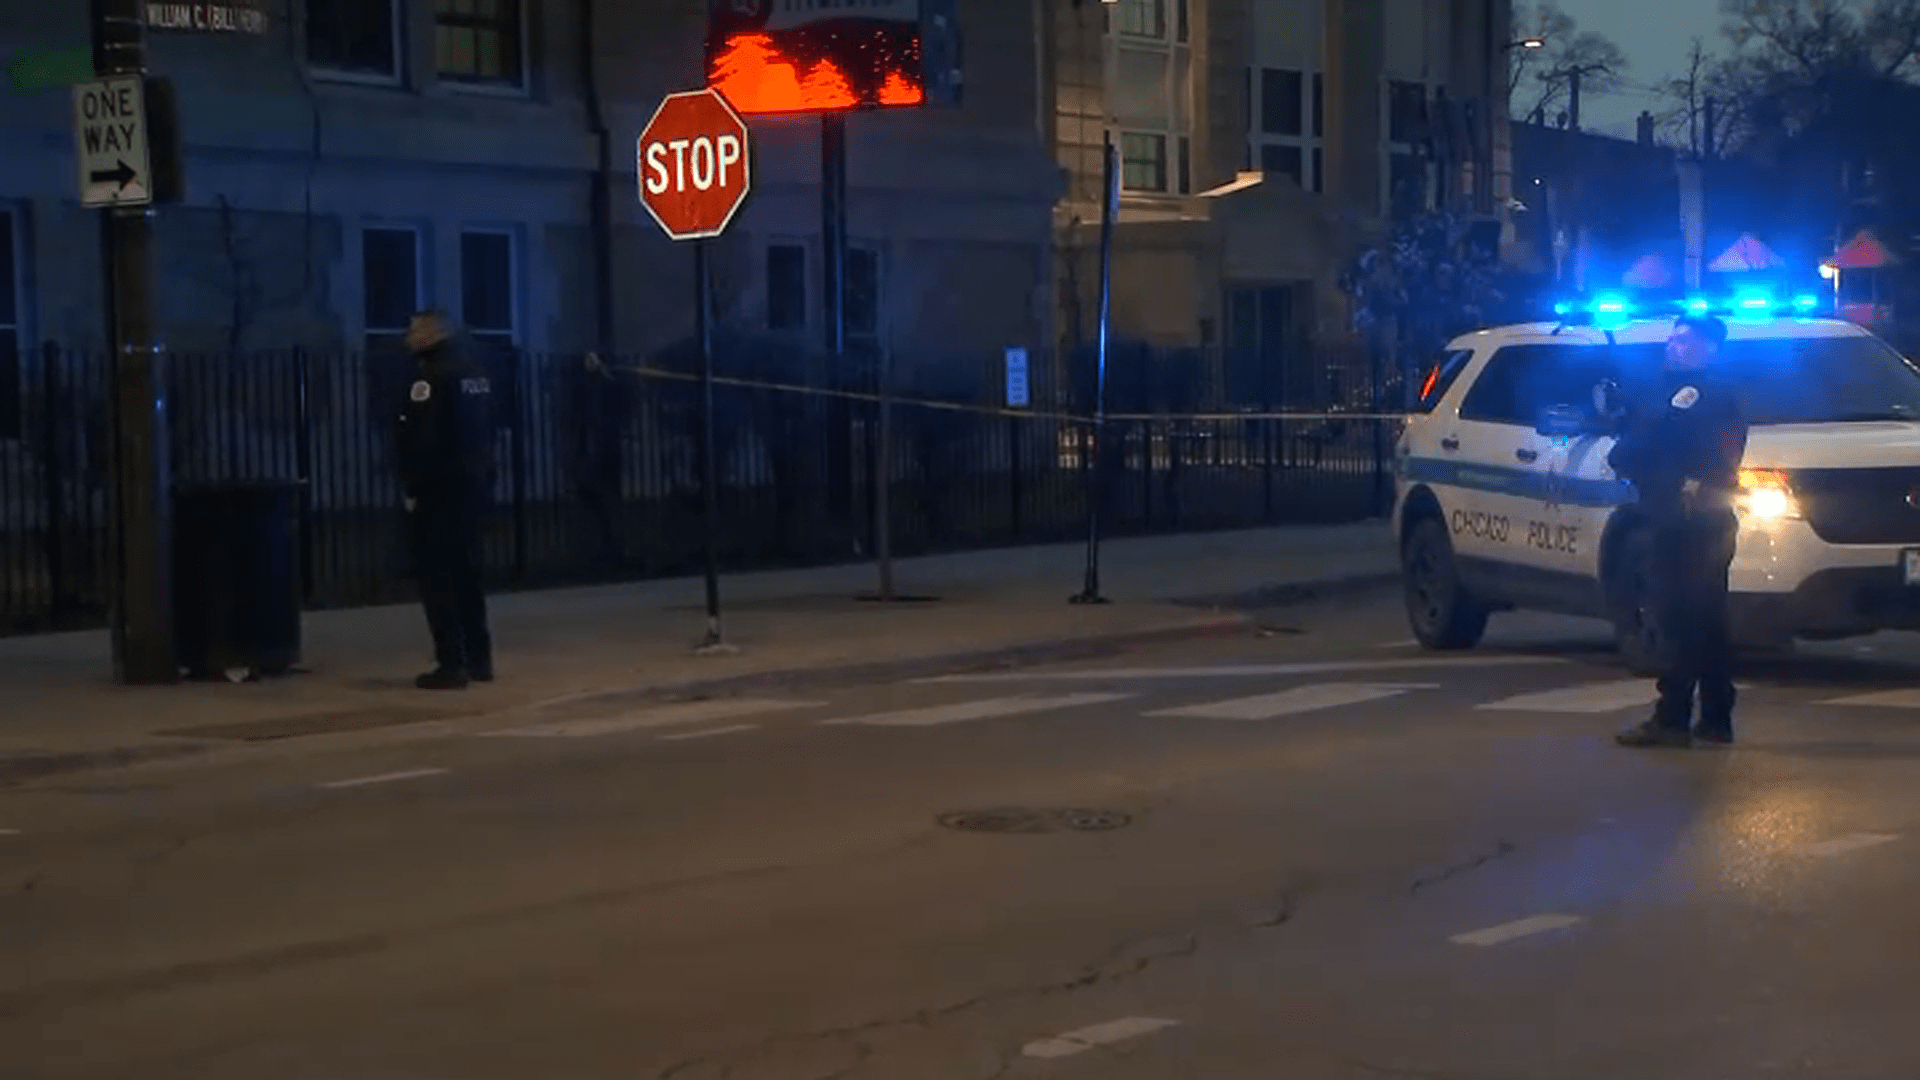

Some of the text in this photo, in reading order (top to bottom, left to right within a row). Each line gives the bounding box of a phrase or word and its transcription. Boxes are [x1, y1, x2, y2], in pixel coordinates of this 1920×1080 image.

[82, 88, 134, 120] ONE
[83, 123, 136, 155] WAY
[646, 135, 740, 195] STOP
[1452, 509, 1579, 553] CHICAGO POLICE
